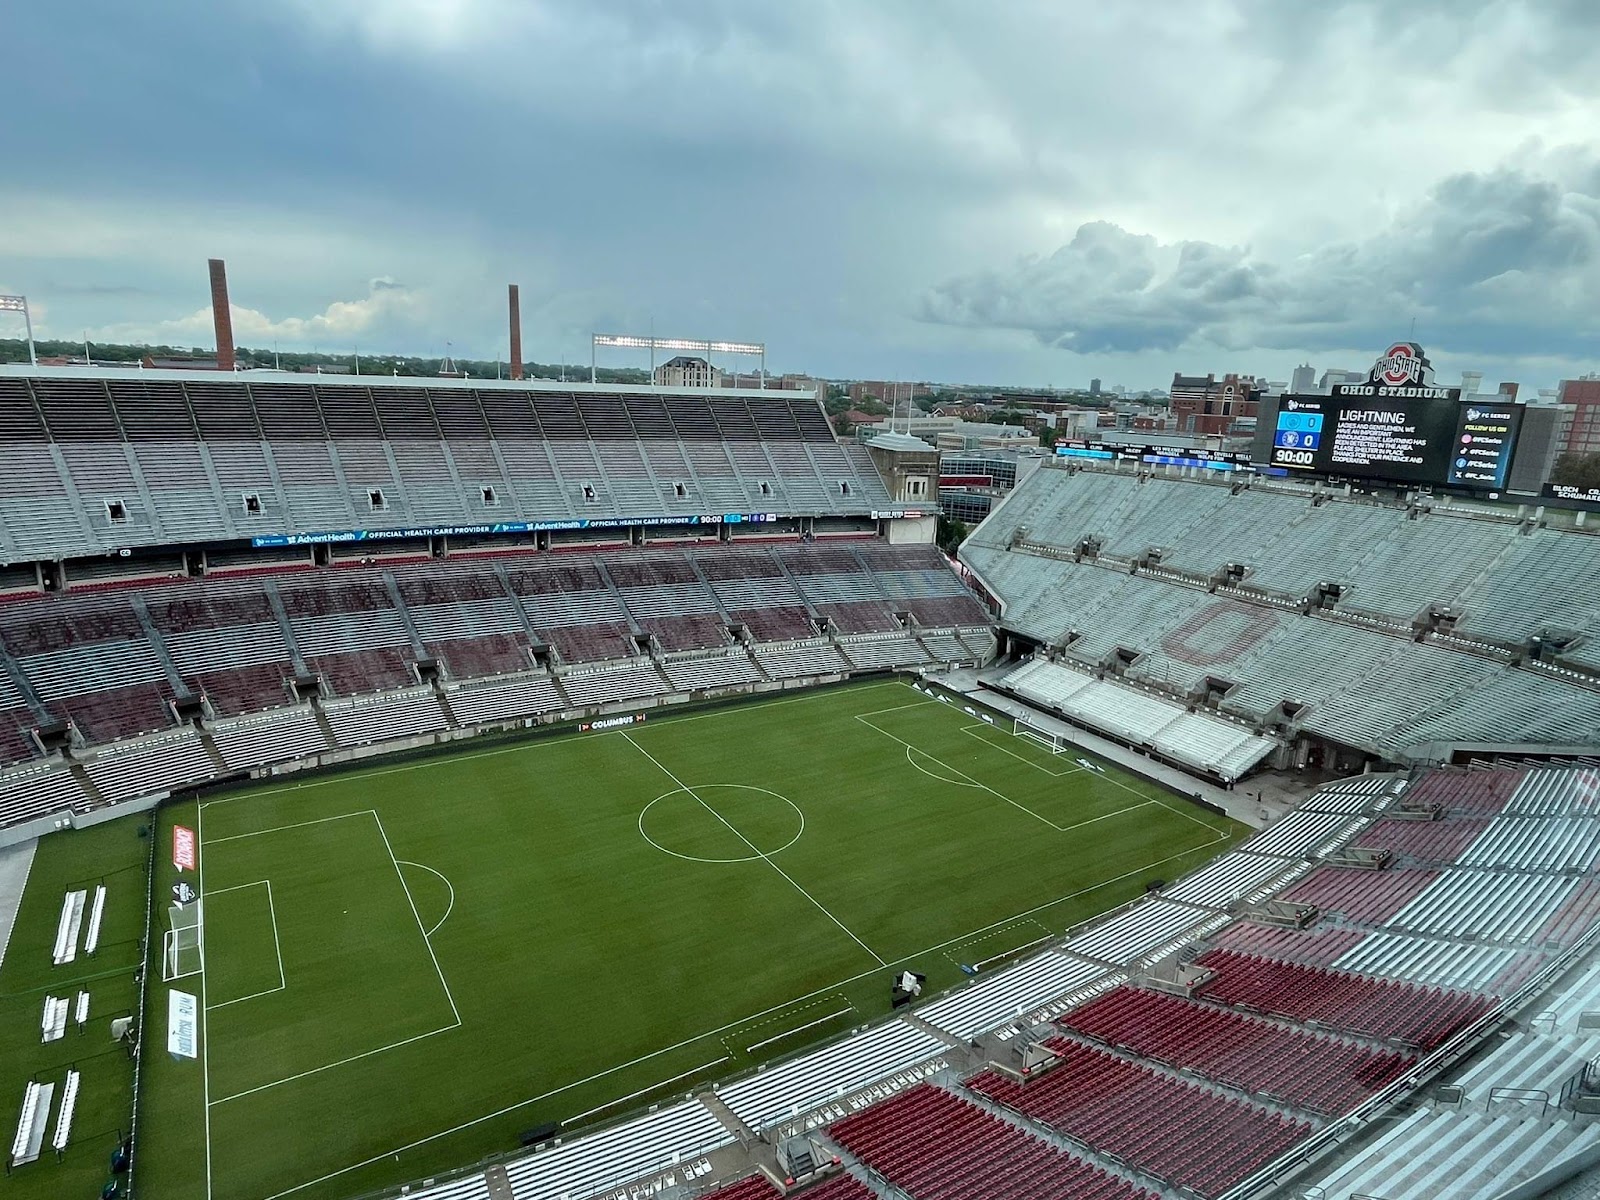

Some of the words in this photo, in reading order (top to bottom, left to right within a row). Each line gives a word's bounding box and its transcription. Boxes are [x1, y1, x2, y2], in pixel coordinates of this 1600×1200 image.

[1374, 357, 1395, 382] OHIO
[1394, 354, 1421, 384] STATE
[1340, 386, 1375, 396] OHIO
[1378, 386, 1450, 399] STADIUM
[1308, 417, 1316, 428] 0
[1339, 410, 1405, 424] LIGHTNING
[1304, 435, 1314, 447] 0
[1276, 450, 1314, 464] 90:00
[1552, 485, 1579, 493] BLOCH
[700, 516, 722, 524] 90:00
[297, 533, 355, 544] AdventHealth
[368, 530, 403, 539] OFFICIAL
[535, 521, 580, 530] AdventHealth
[591, 716, 634, 730] COLUMBUS
